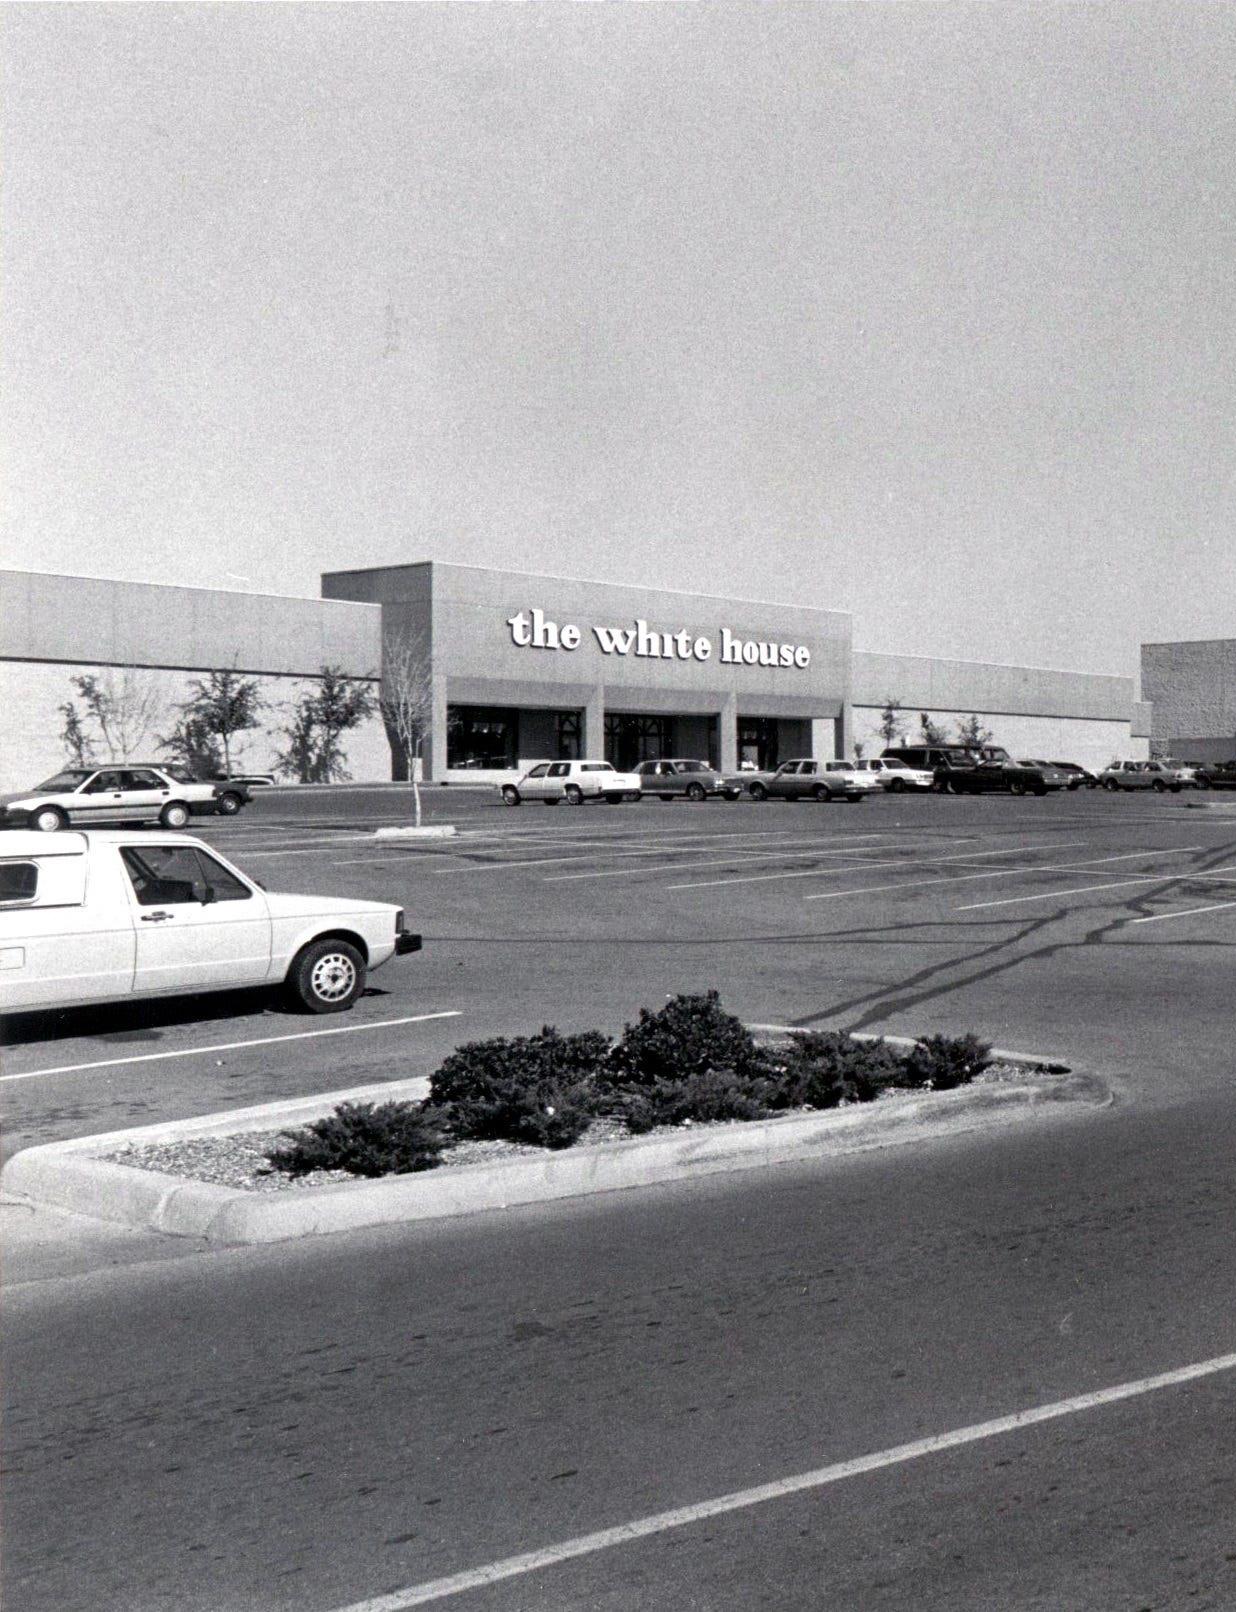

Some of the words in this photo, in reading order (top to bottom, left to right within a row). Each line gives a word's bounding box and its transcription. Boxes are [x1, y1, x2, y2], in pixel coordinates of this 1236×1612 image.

[507, 608, 581, 649] the
[593, 619, 712, 661] white
[720, 628, 810, 668] house
